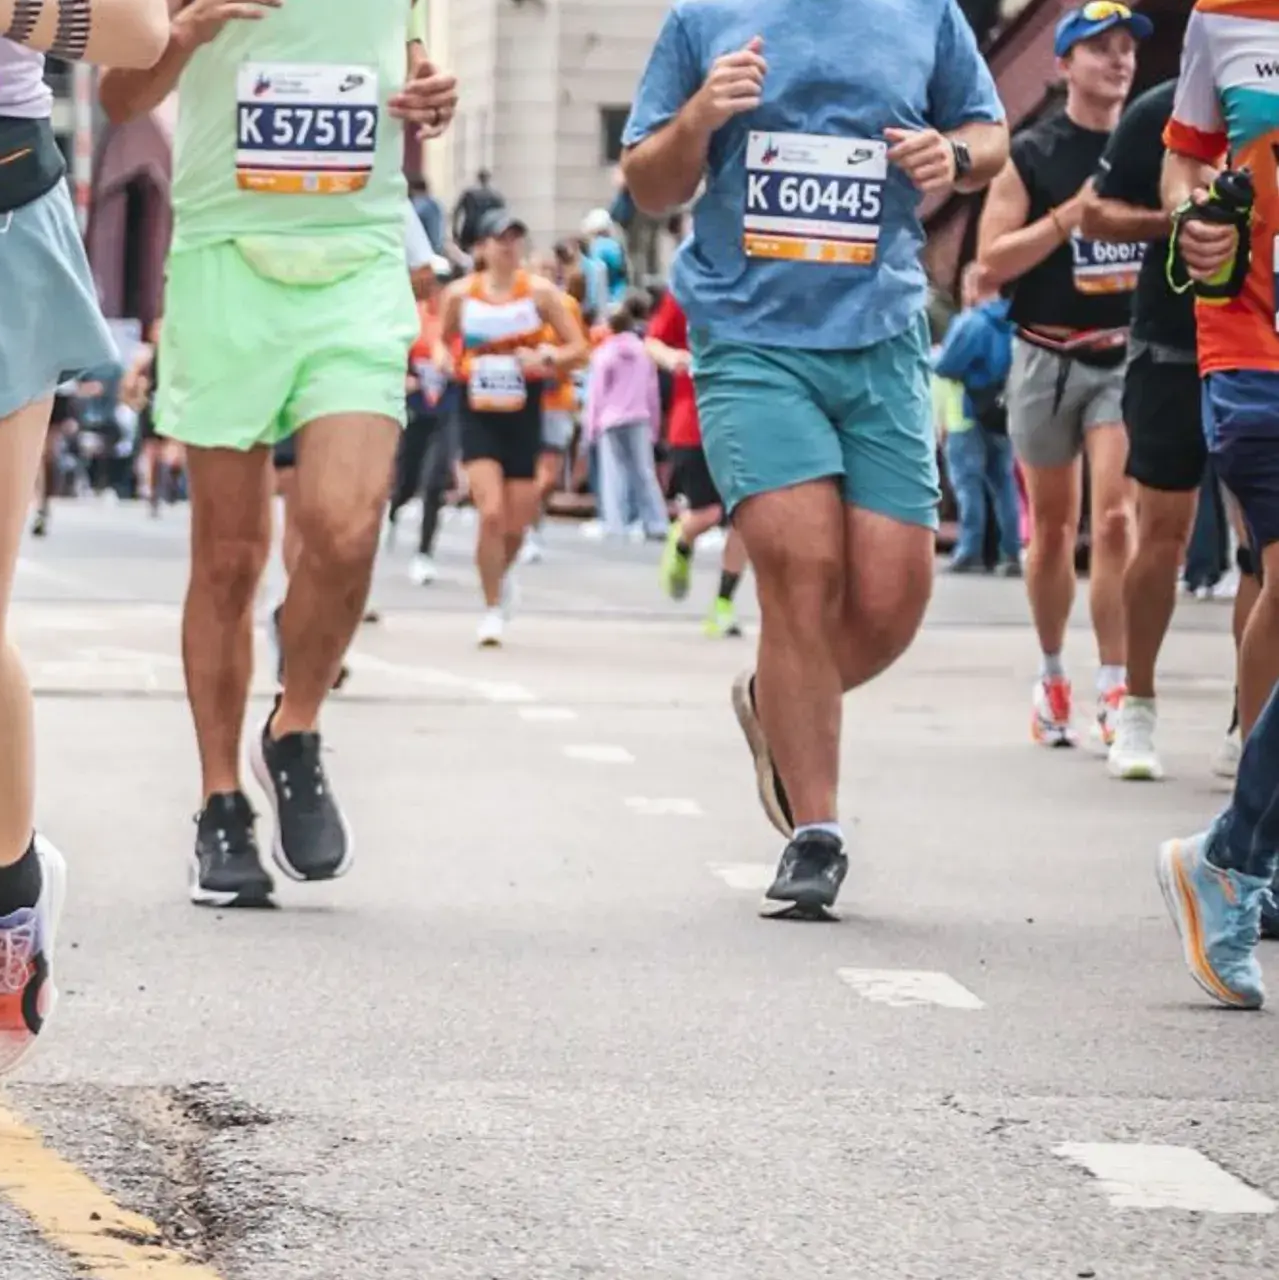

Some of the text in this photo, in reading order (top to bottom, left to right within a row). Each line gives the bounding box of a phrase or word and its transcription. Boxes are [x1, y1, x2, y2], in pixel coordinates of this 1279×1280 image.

[240, 108, 374, 146] K 57512
[747, 174, 882, 219] K 60445
